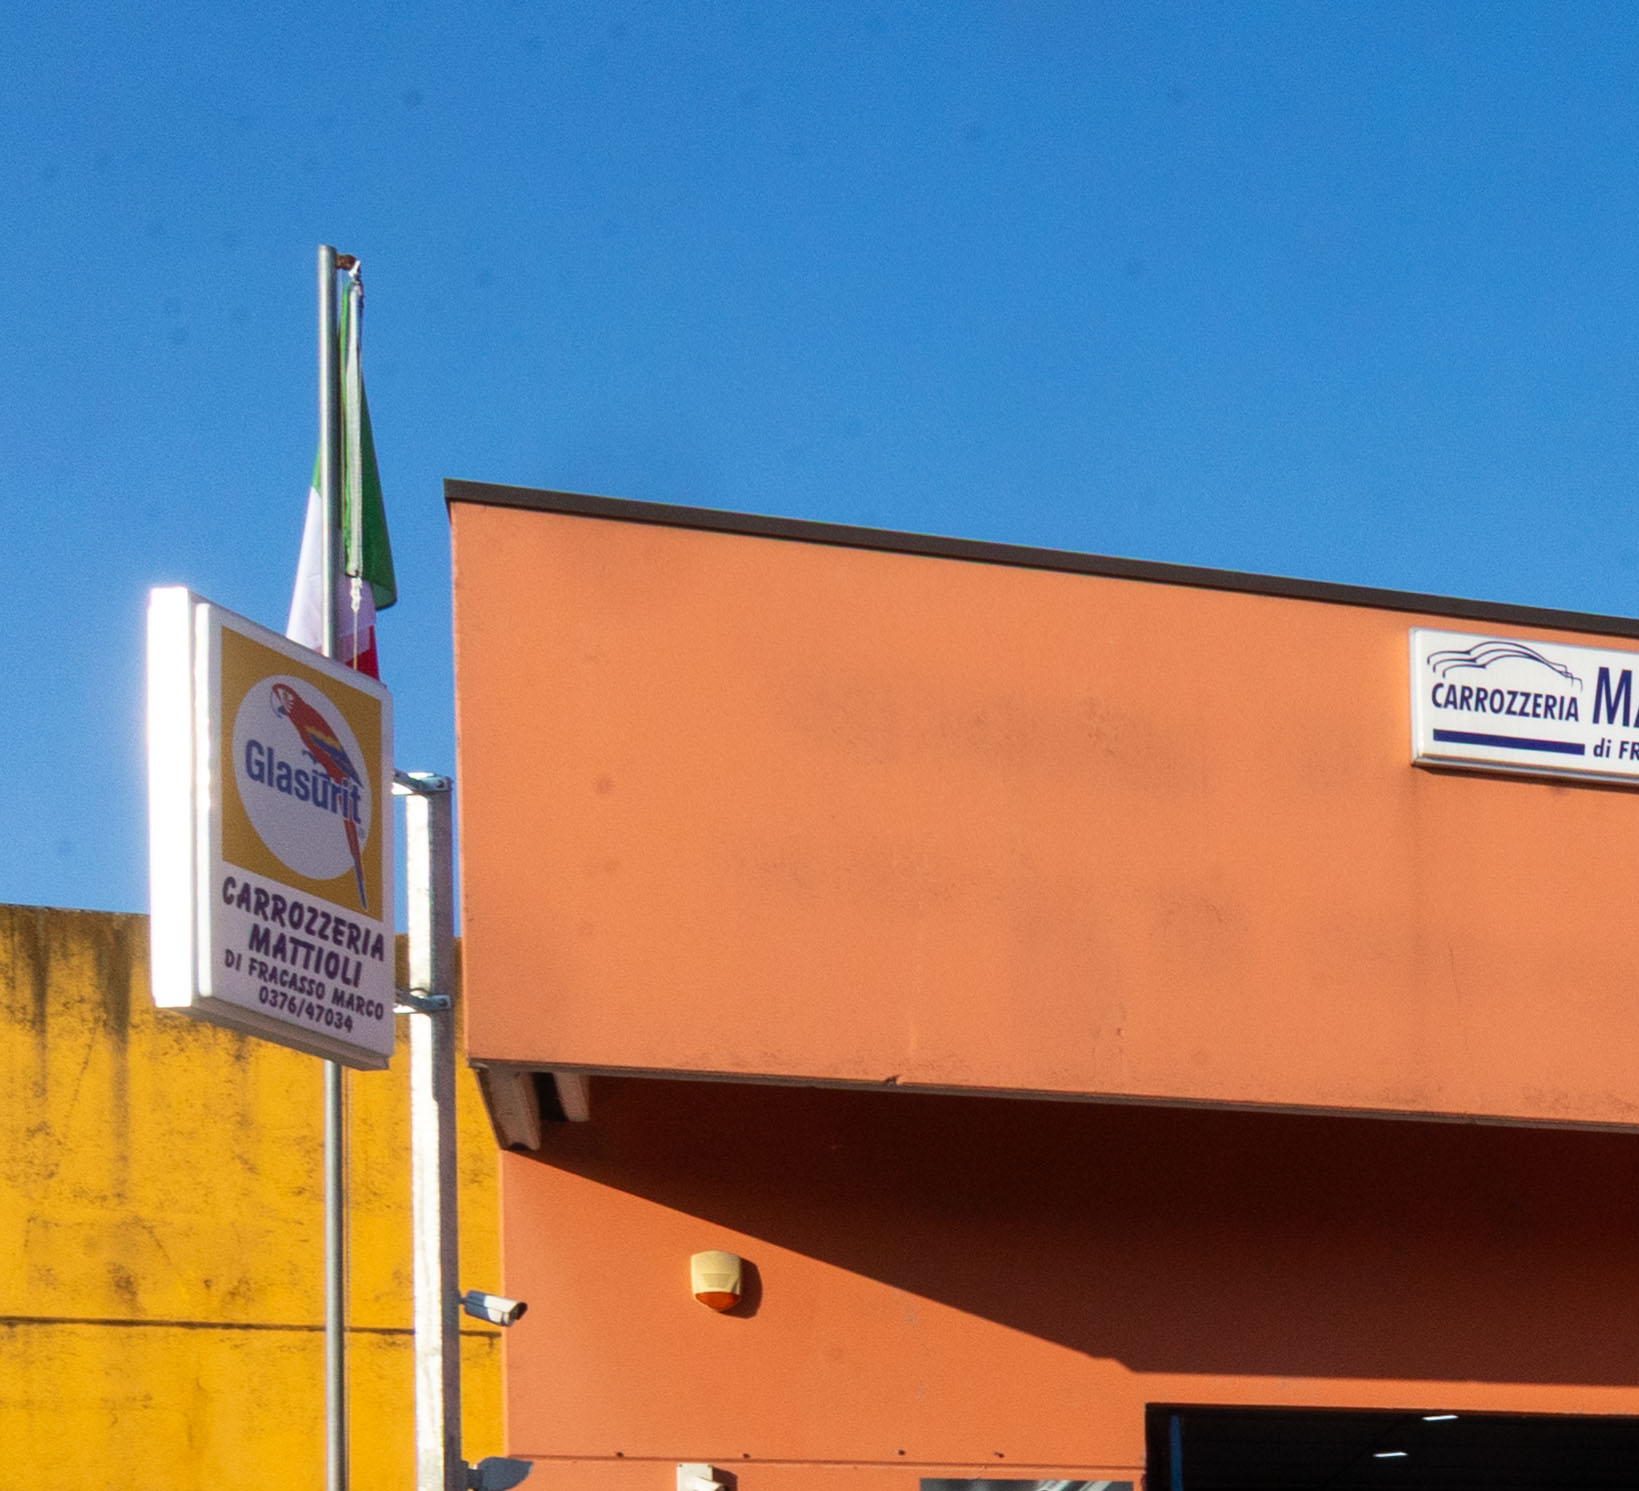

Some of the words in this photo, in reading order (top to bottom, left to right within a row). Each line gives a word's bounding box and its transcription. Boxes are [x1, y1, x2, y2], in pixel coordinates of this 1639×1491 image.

[1430, 681, 1581, 722] CARROZZERIA
[1592, 736, 1612, 759] di
[245, 738, 362, 825] Glasurit
[221, 875, 386, 963] CARROZZERIA
[224, 948, 243, 972] DI
[248, 957, 327, 1001] FRACASSO
[331, 987, 385, 1022] MARCO
[248, 922, 363, 989] MATTIOLI
[258, 985, 354, 1034] 0376/47034
